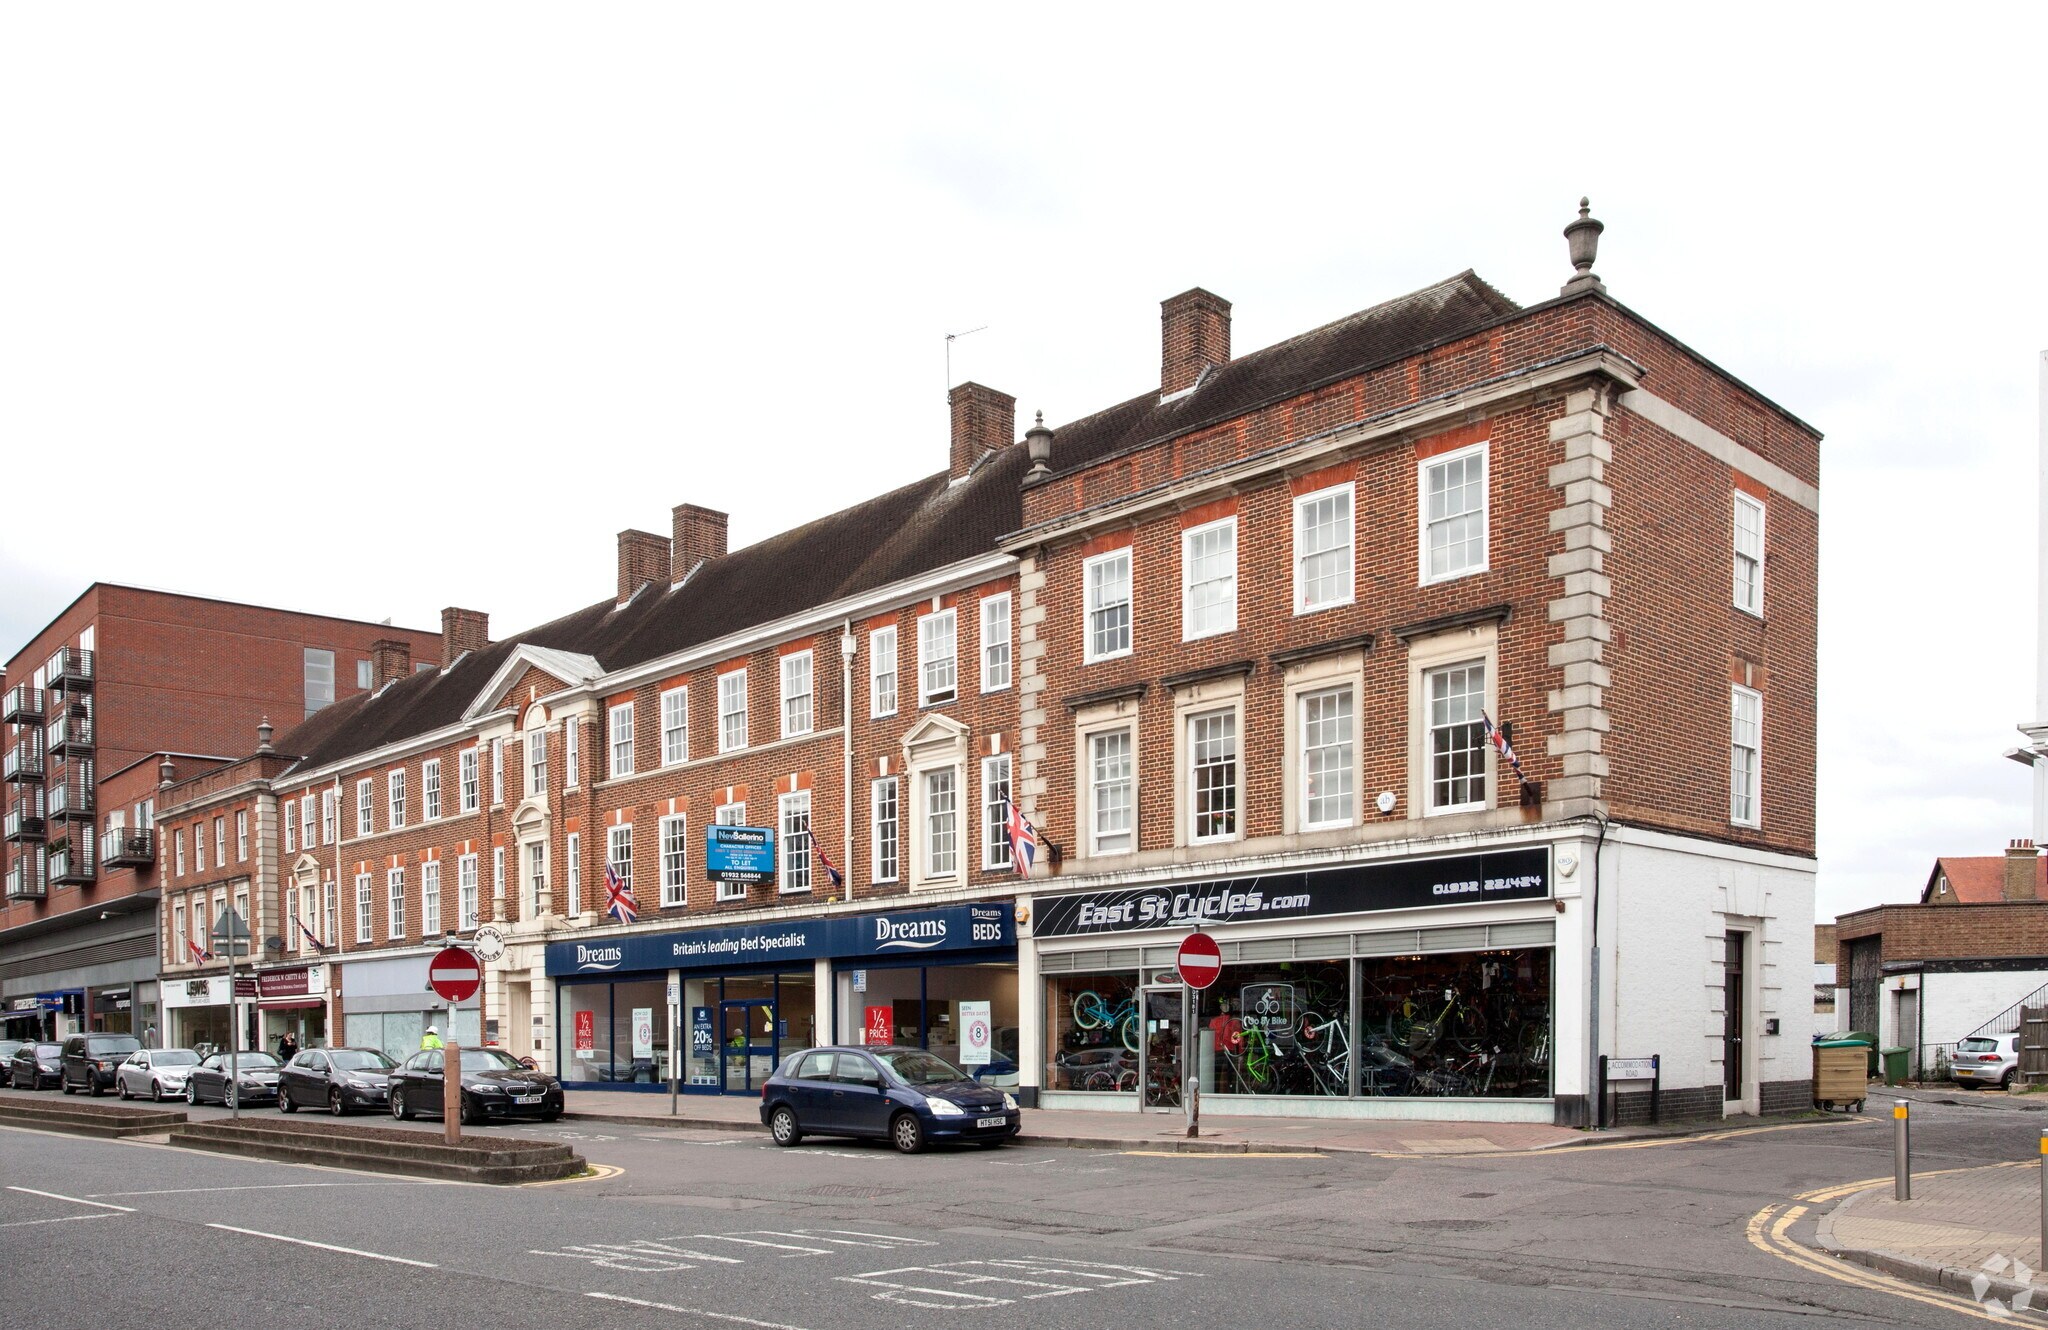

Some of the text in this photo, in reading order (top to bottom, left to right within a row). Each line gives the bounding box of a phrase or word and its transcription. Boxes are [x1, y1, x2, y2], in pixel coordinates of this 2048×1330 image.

[1433, 875, 1541, 895] 01932 221424
[971, 907, 1002, 917] Dreams
[1078, 901, 1135, 926] East
[1139, 894, 1169, 920] St
[875, 917, 946, 941] Dreams
[972, 923, 1002, 941] BEDS
[476, 930, 502, 943] BRASSEY
[673, 933, 805, 956] Britain's leading Bed Specialist
[477, 949, 500, 960] HOUSE
[577, 945, 621, 963] Dreams
[1271, 1016, 1287, 1025] Bike
[579, 1029, 591, 1037] PRICE
[693, 1030, 712, 1043] 20%
[869, 1029, 887, 1038] PRICE
[975, 1027, 981, 1038] 8
[579, 1041, 591, 1050] SALE
[1612, 1061, 1652, 1069] ACCOMMODATION
